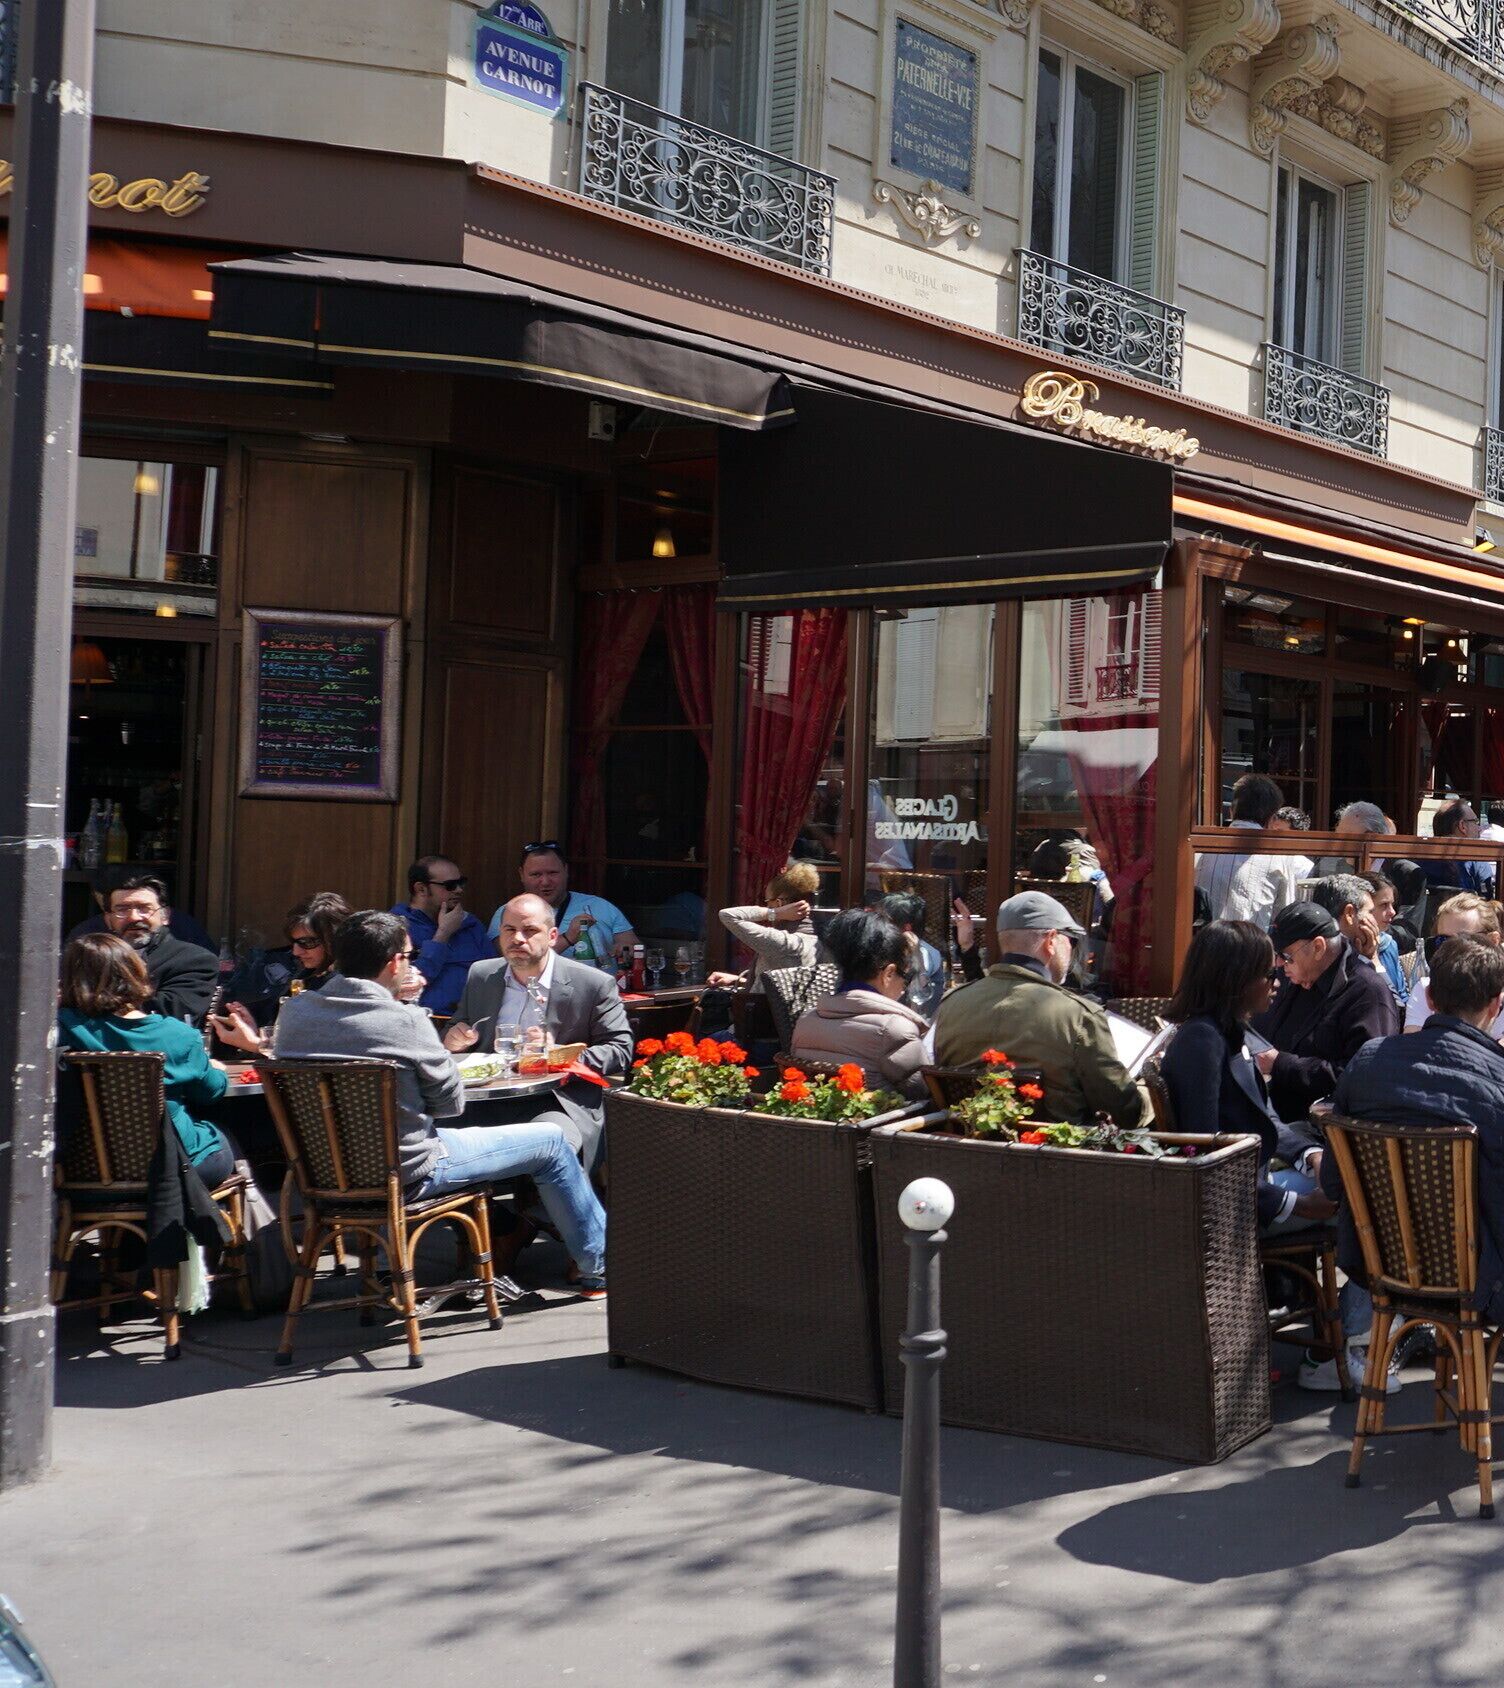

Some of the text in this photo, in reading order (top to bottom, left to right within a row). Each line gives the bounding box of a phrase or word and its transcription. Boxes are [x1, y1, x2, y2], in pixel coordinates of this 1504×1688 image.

[485, 41, 554, 78] AVENUE
[482, 61, 555, 99] CARNOT
[1021, 371, 1200, 459] Brasserie
